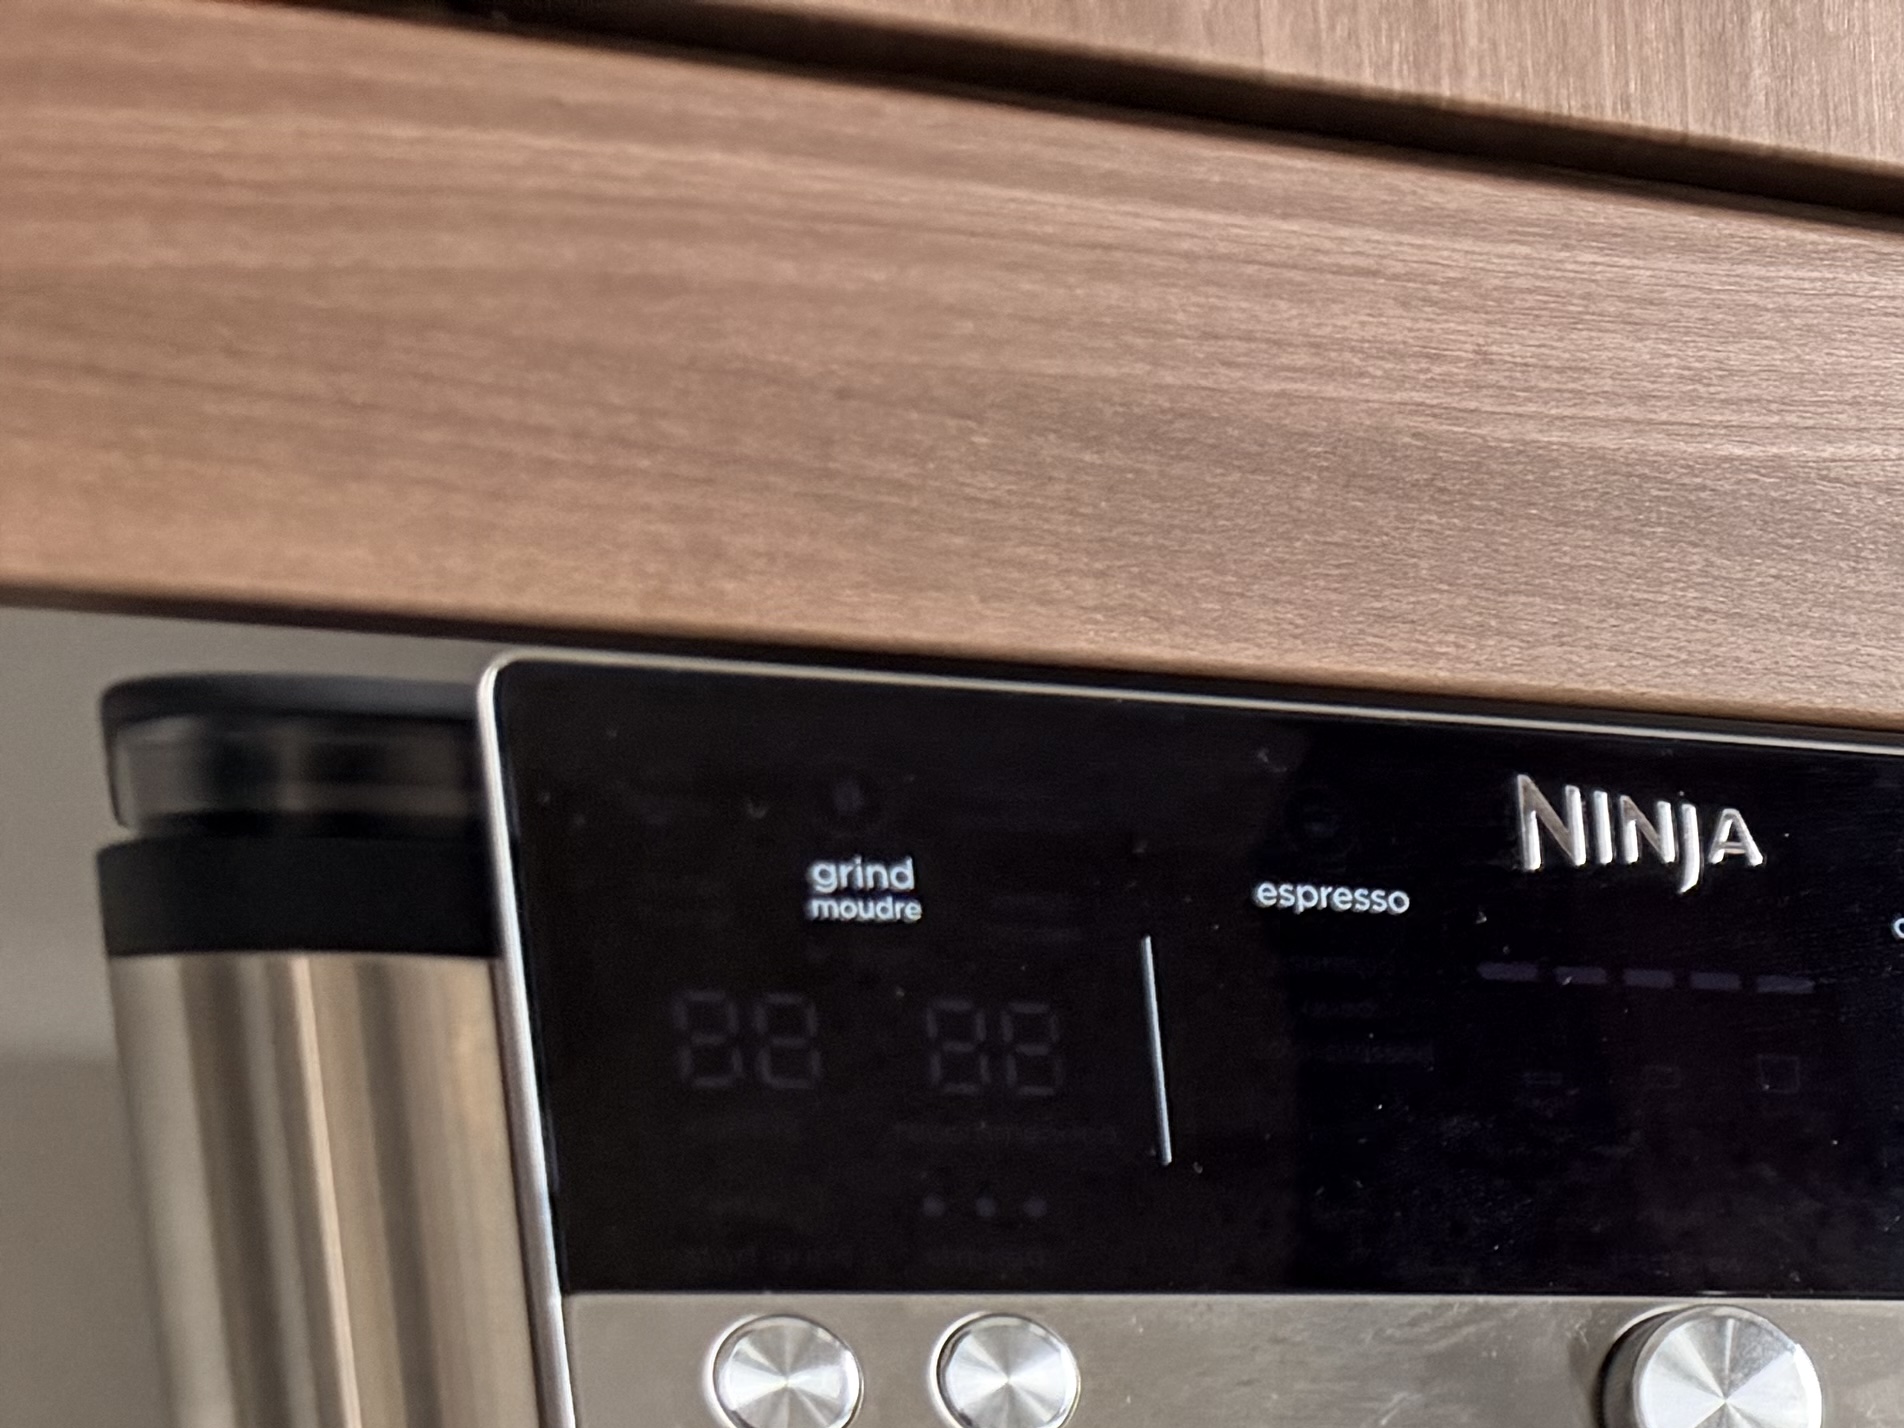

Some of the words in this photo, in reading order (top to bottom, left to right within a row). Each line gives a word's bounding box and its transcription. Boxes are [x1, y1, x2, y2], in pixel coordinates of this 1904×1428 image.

[1517, 774, 1764, 894] NINJA
[811, 856, 914, 893] grind
[811, 896, 922, 921] moudre
[1254, 879, 1410, 914] espresso
